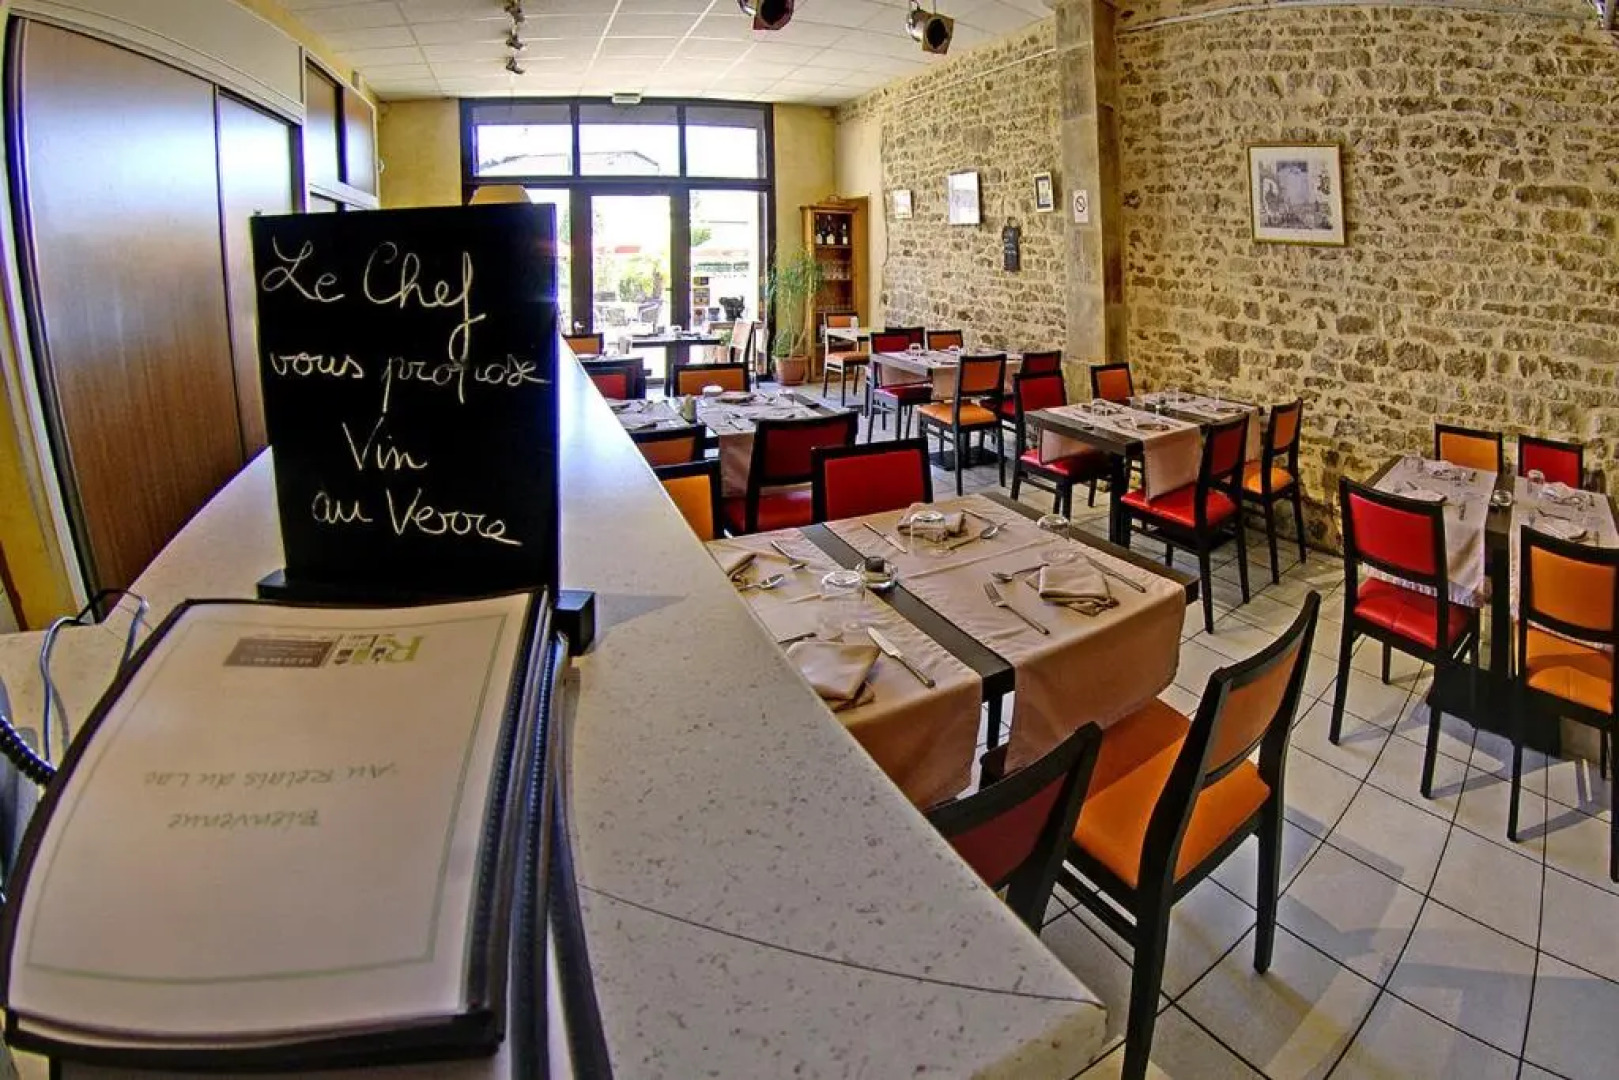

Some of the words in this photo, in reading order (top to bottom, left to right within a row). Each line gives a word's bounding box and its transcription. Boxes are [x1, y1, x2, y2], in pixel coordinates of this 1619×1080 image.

[262, 235, 345, 303] Le
[363, 240, 486, 363] Chef
[270, 350, 364, 377] vous
[381, 353, 551, 414] propose
[342, 415, 427, 470] Vin
[312, 491, 372, 523] au
[386, 488, 523, 546] Verre
[200, 771, 235, 788] du
[244, 767, 335, 787] Relais
[167, 809, 320, 830] Bienvenue
